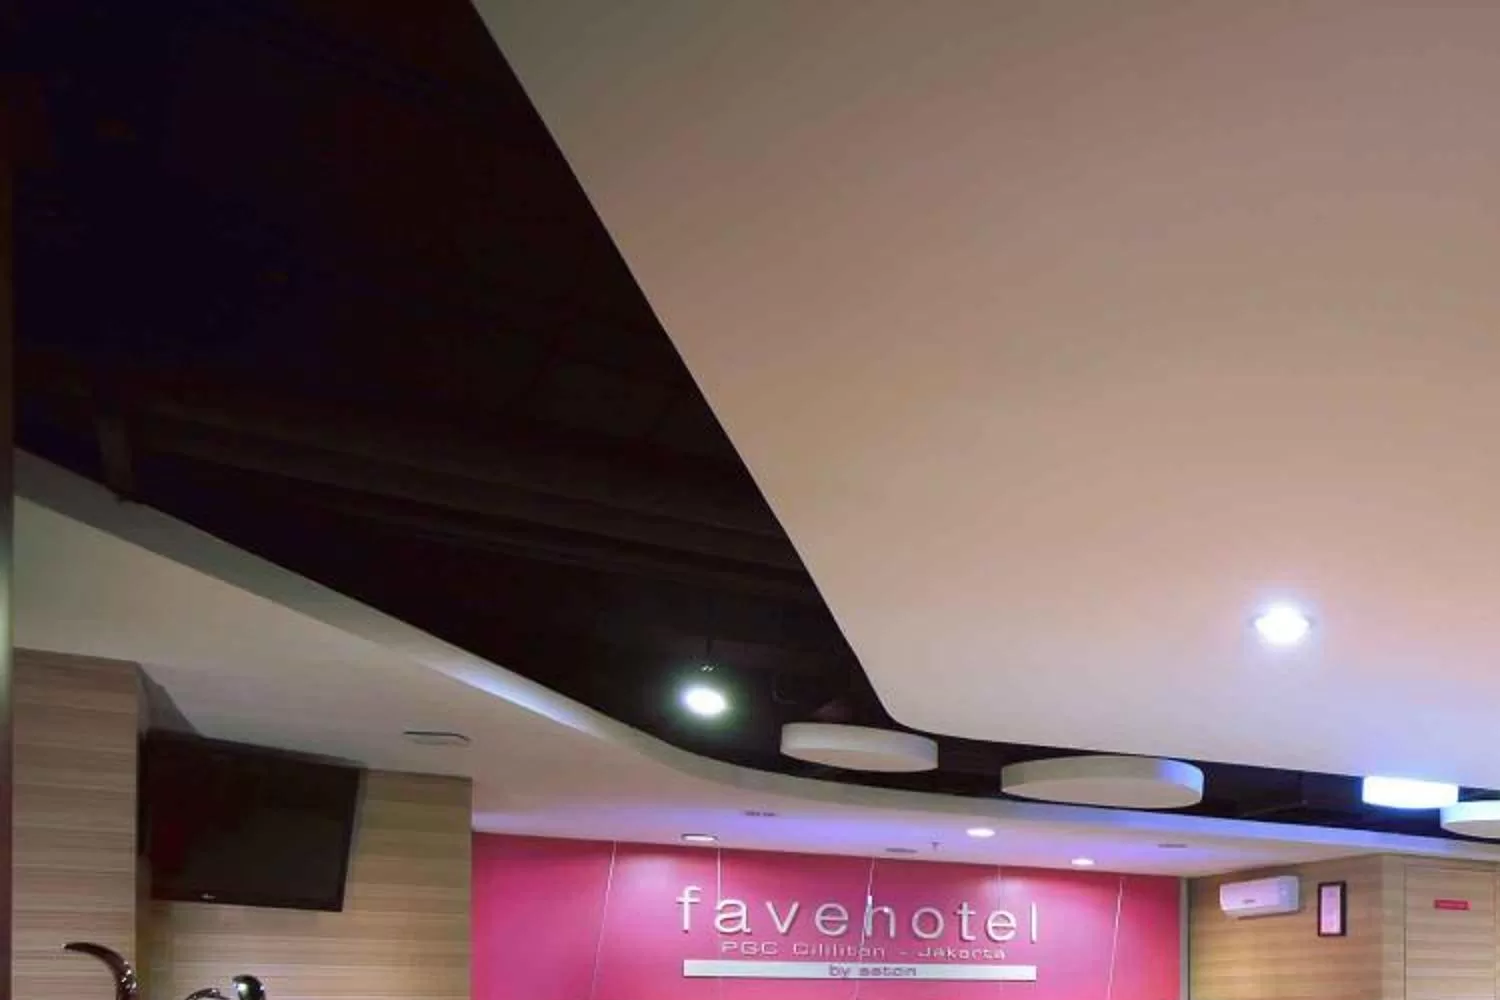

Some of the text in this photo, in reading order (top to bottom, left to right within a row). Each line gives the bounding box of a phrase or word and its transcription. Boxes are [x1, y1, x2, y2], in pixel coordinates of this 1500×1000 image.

[676, 885, 1038, 943] favehotel
[721, 941, 778, 955] PGC
[829, 964, 917, 980] by aston
